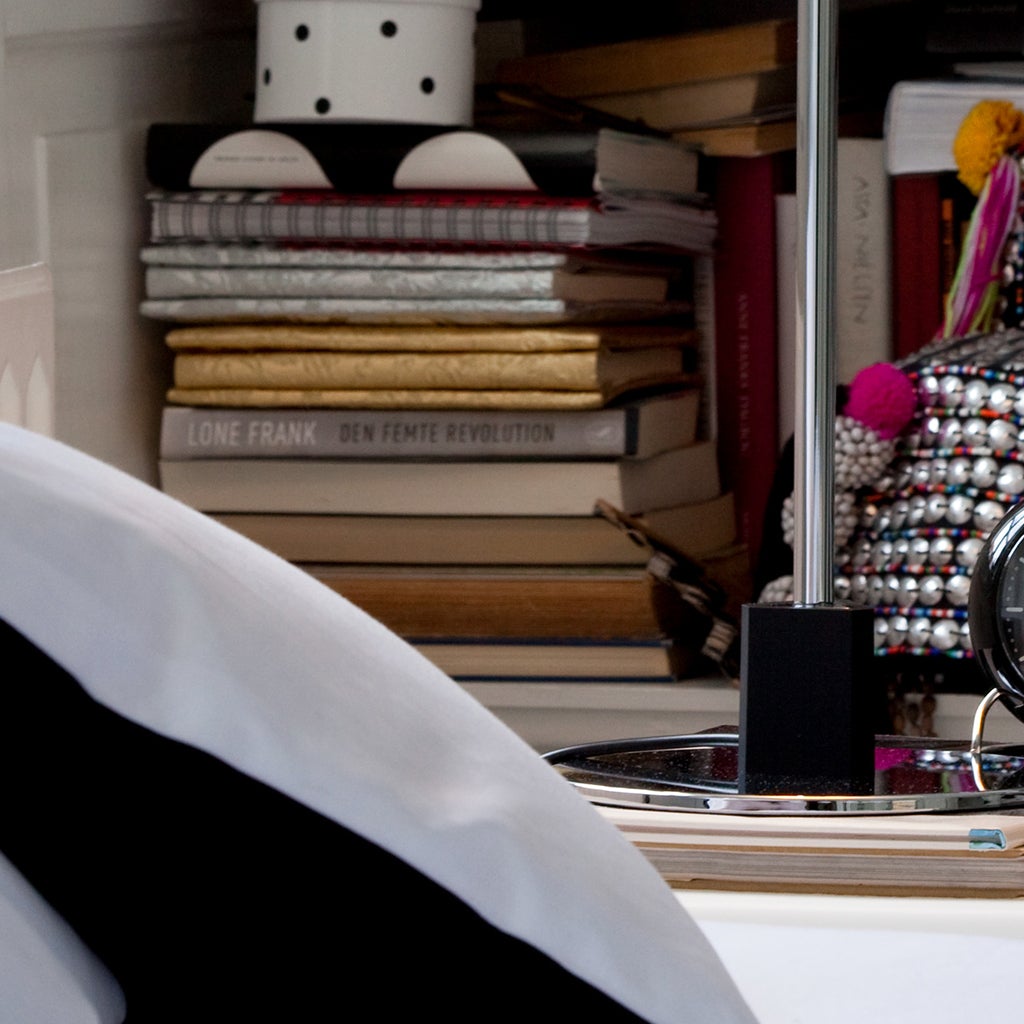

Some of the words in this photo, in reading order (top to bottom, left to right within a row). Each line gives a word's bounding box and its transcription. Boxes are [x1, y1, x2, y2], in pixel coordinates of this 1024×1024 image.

[187, 421, 241, 447] LONE
[248, 420, 318, 445] FRANK
[339, 423, 374, 444] DEN
[382, 423, 438, 443] FEMTE
[446, 423, 556, 443] REVOLUTION
